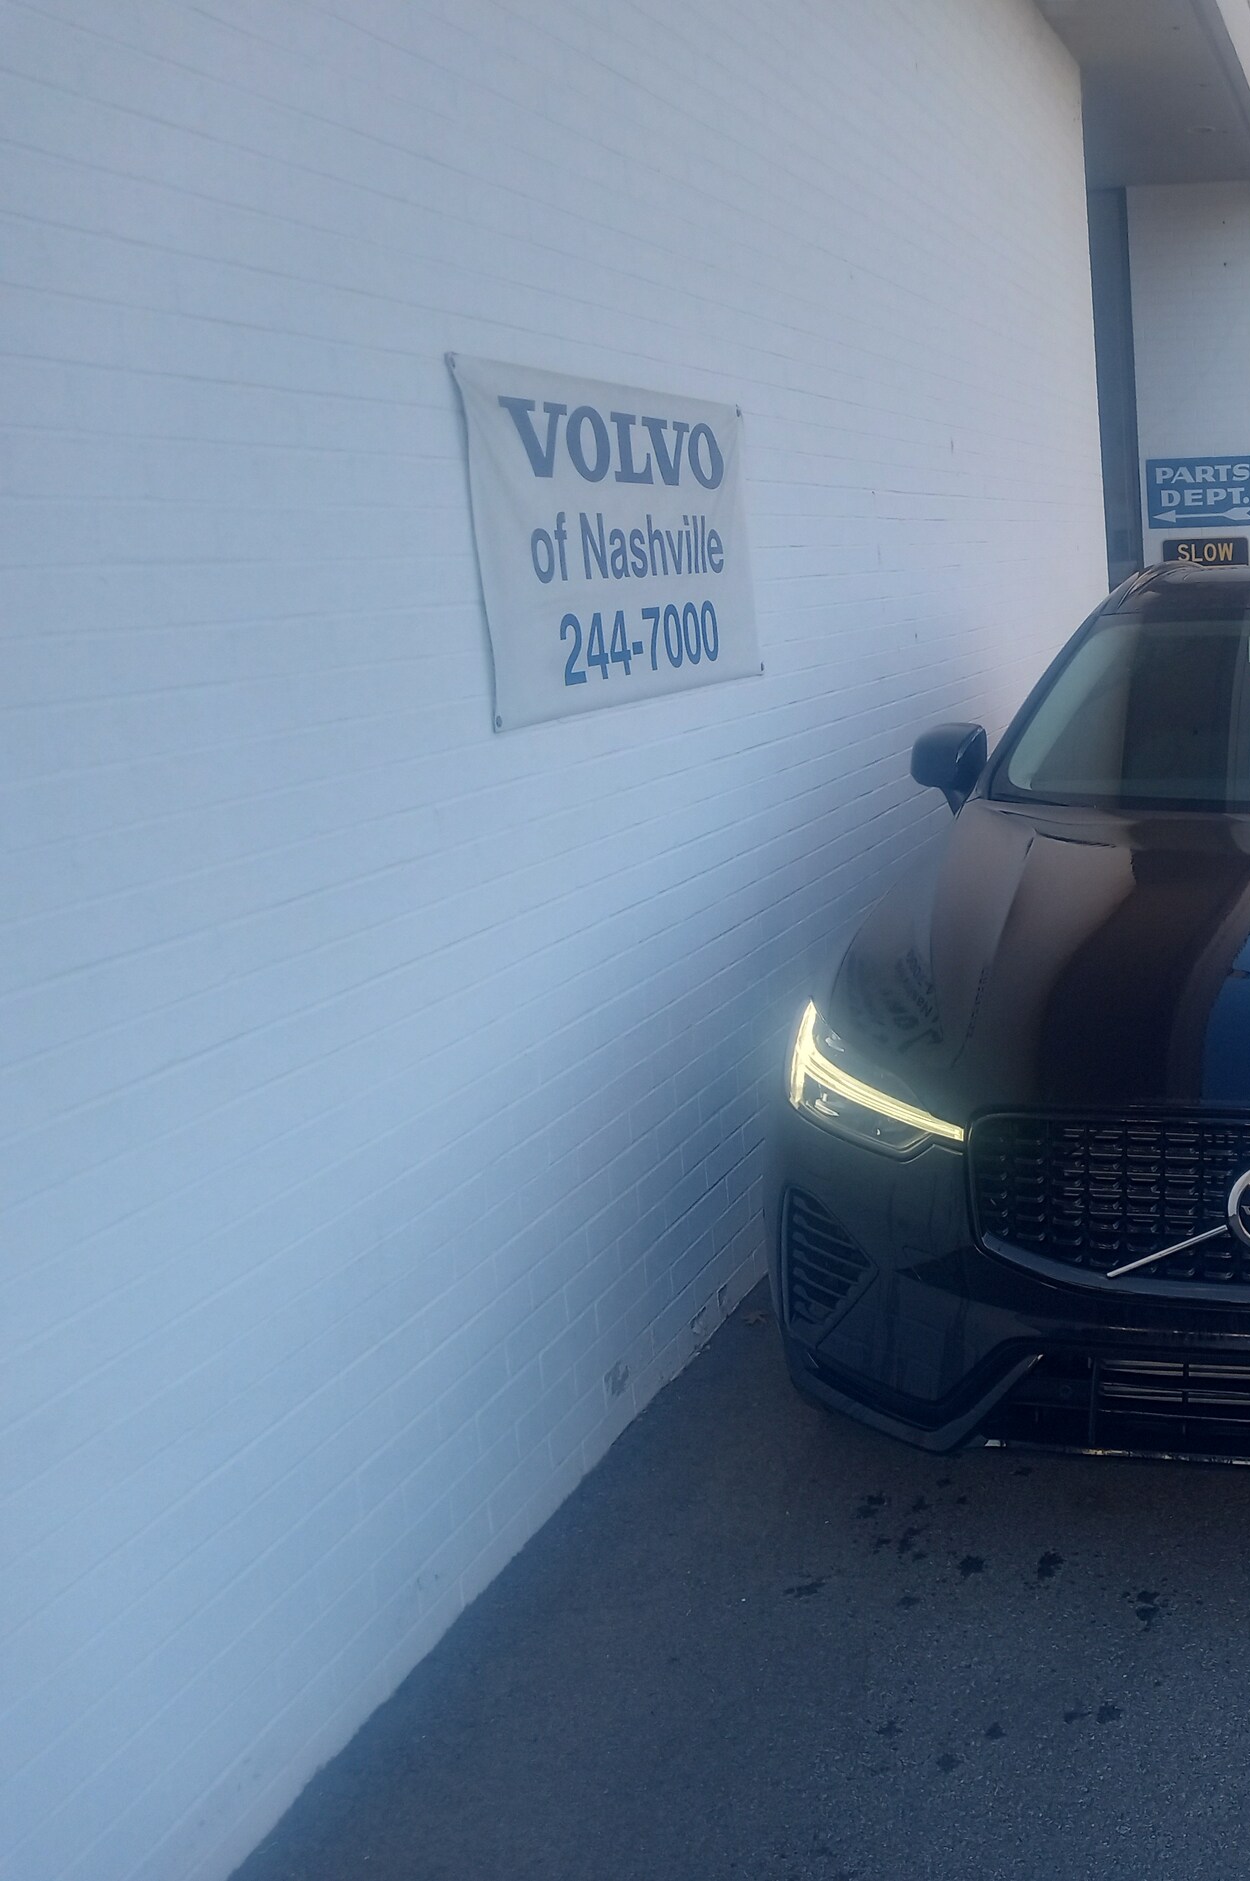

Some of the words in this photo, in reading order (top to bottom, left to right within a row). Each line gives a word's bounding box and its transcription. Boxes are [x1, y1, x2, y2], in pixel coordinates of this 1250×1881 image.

[498, 396, 724, 489] VOLVO
[1155, 463, 1250, 484] PARTS
[1160, 487, 1250, 507] DEPT.
[530, 511, 569, 584] of
[579, 512, 725, 580] Nashville
[1177, 542, 1234, 562] SLOW
[560, 600, 719, 686] 244-7000
